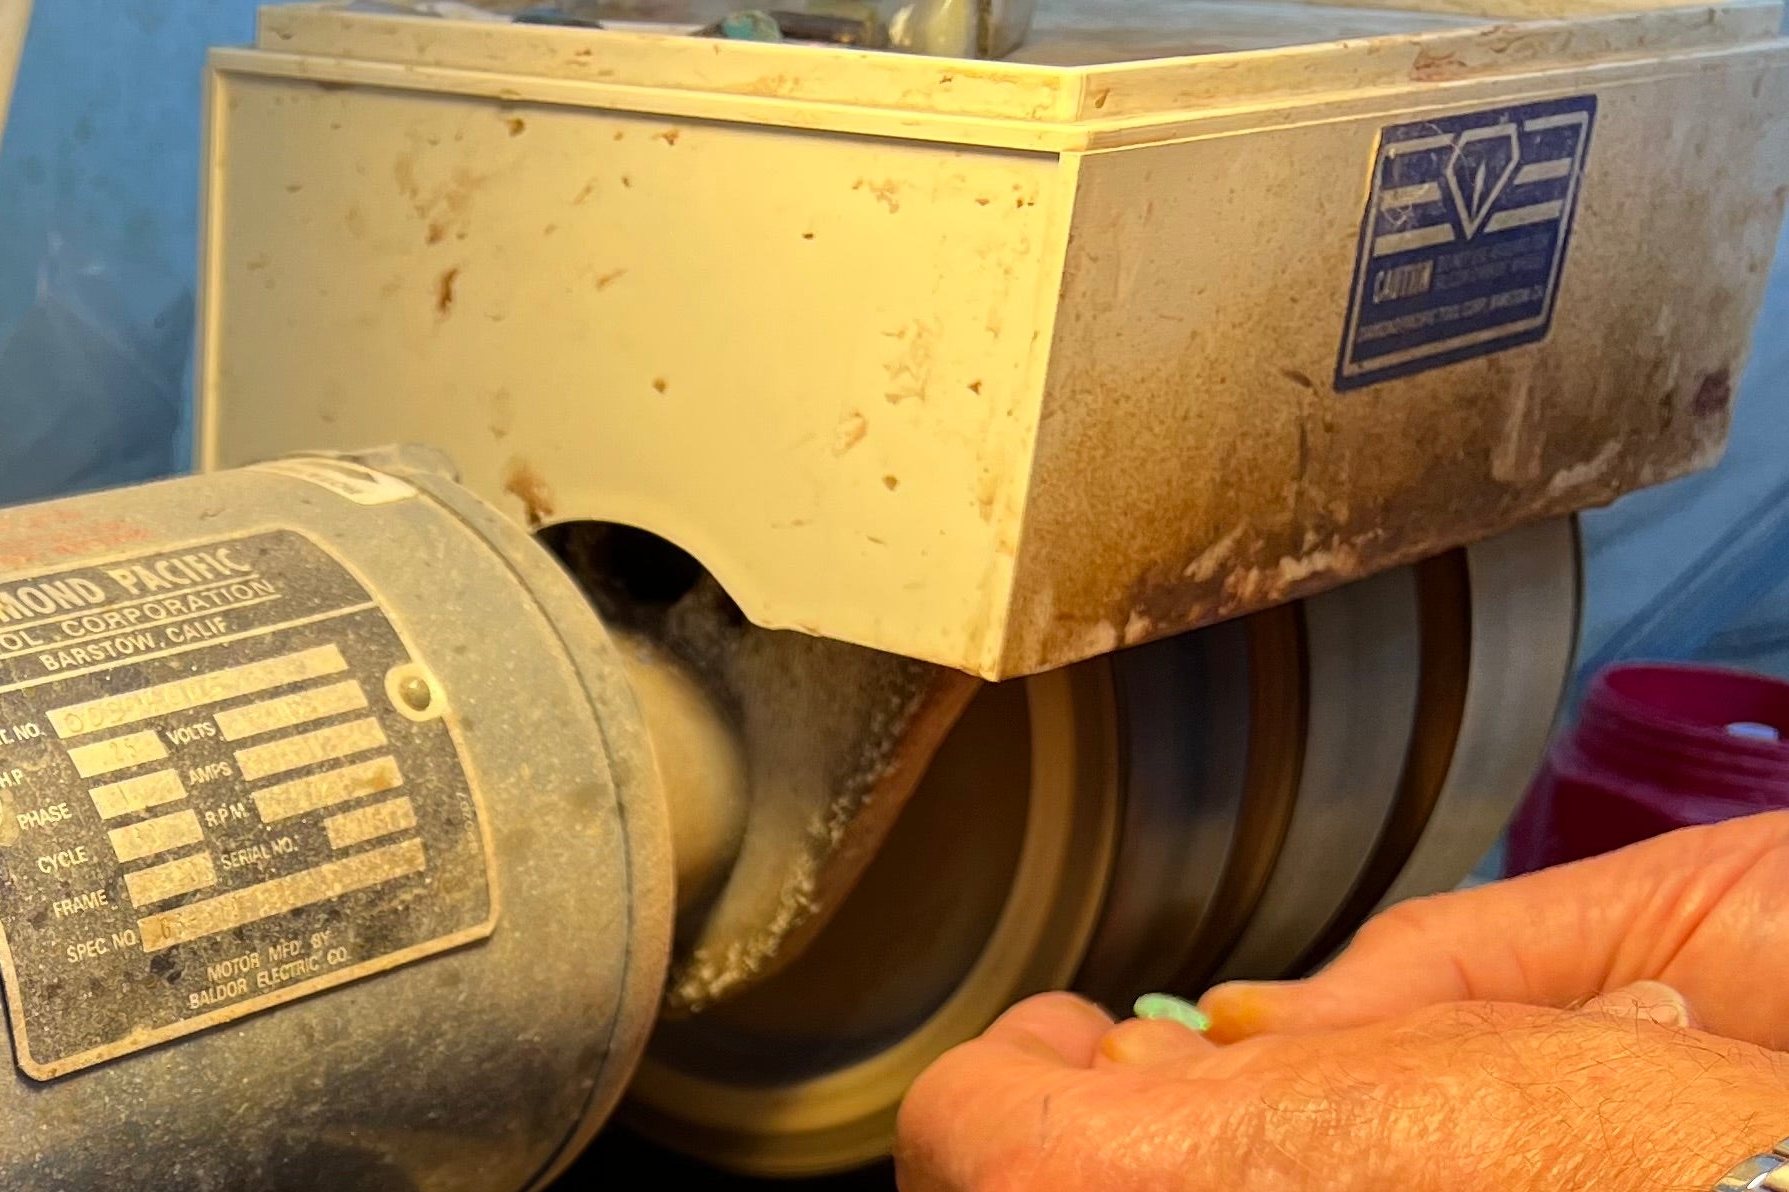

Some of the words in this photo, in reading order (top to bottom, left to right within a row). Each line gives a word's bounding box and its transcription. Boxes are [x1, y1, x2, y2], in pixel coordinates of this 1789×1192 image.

[107, 547, 253, 595] PACIFIC
[60, 577, 276, 638] CORPORATION
[165, 721, 216, 746] VOLTS
[188, 760, 233, 787] AMPS
[16, 801, 73, 831] PHASE
[37, 845, 89, 874] CYCLE
[220, 842, 273, 870] SERIAL
[52, 888, 109, 918] FRAME
[188, 979, 248, 1009] BALDOR
[257, 956, 319, 988] ELECTRIC
[207, 952, 260, 983] MOTOR
